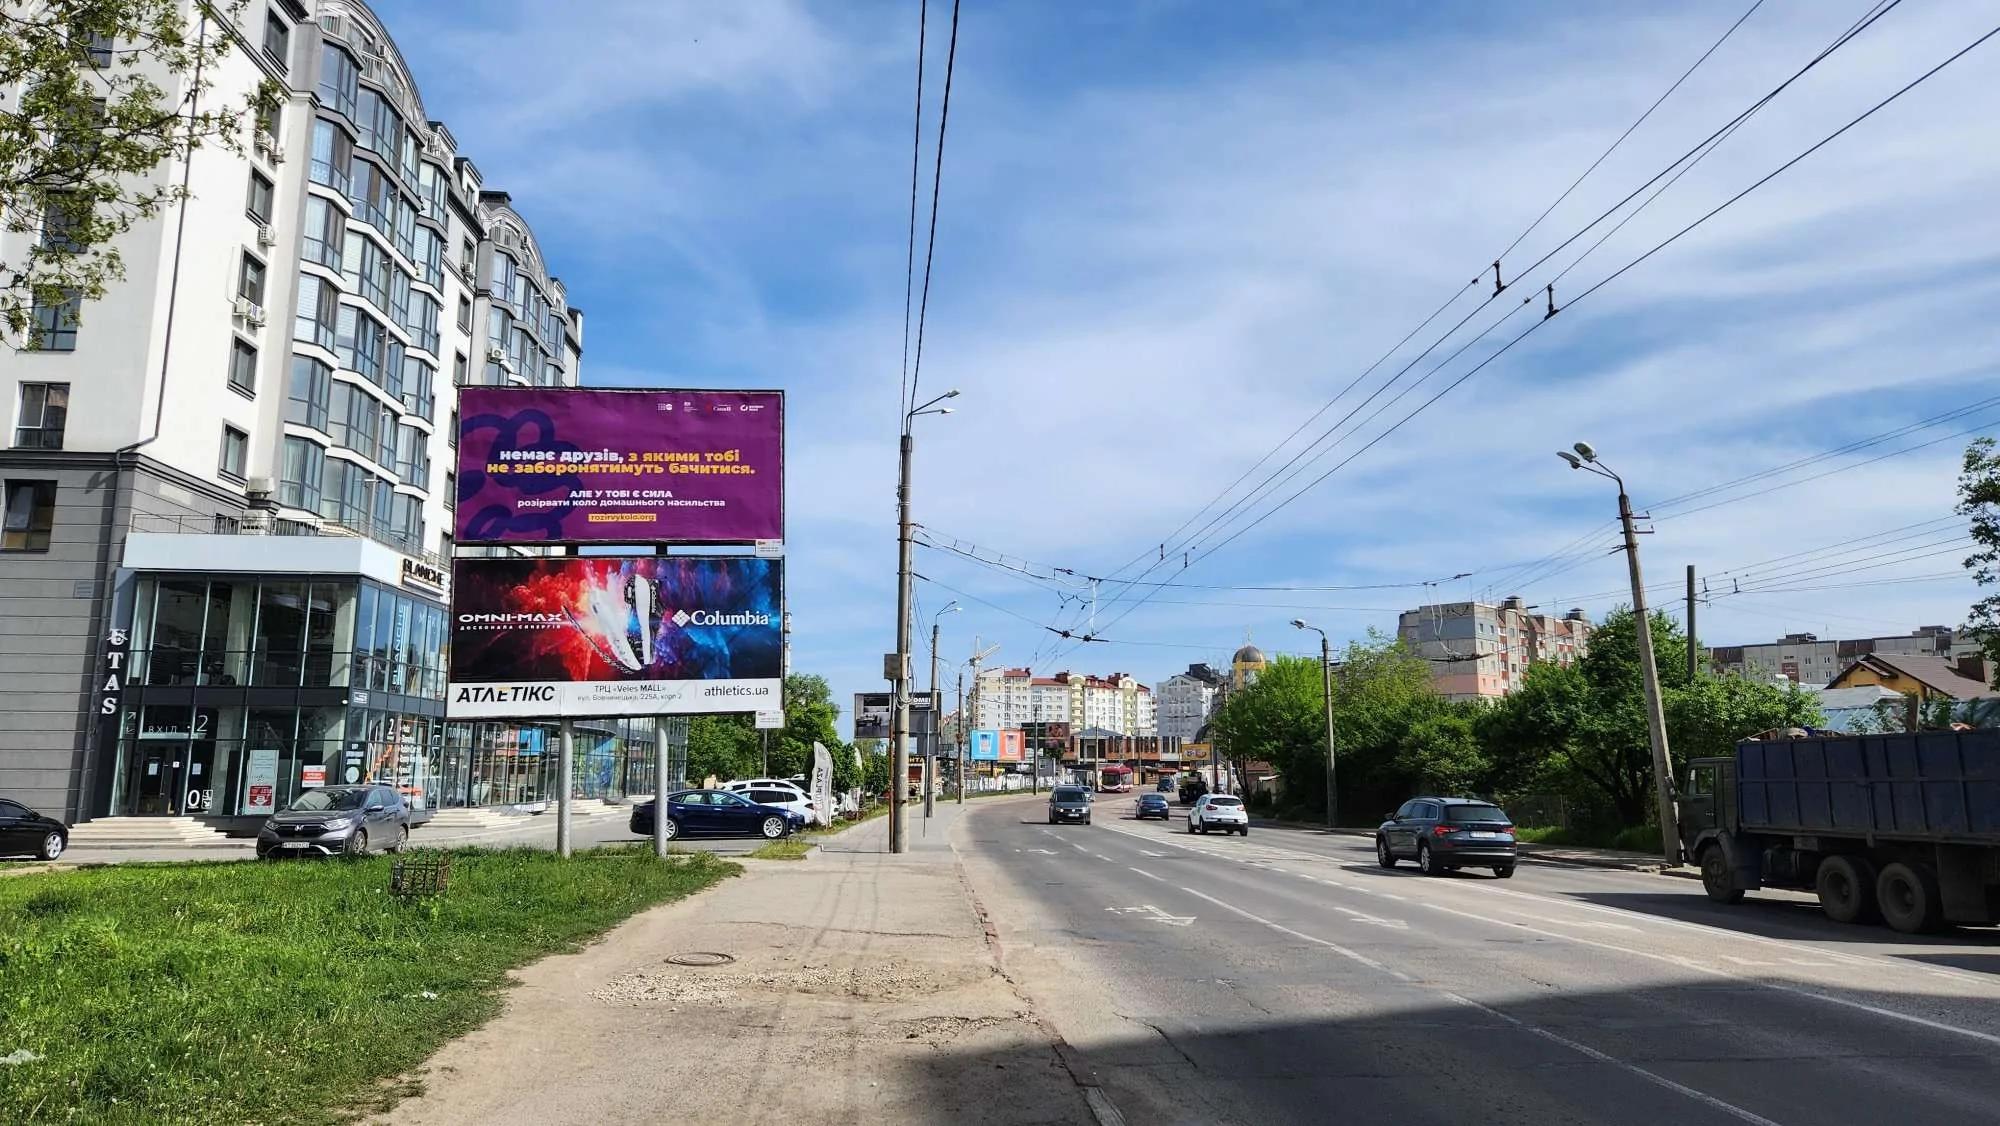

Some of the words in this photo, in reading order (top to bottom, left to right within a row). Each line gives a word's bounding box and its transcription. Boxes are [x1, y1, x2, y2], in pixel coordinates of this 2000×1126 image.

[500, 450, 555, 462] немає
[560, 449, 624, 464] друзів,
[628, 452, 637, 462] з
[643, 452, 699, 463] якими
[705, 450, 739, 463] тобі
[487, 464, 510, 473] не
[514, 462, 662, 476] заборонятимуть
[669, 462, 755, 475] бачитися.
[642, 491, 672, 499] СИЛА
[518, 499, 570, 508] розірвати
[600, 500, 664, 508] домашнього
[402, 558, 445, 585] BLANCHE
[459, 613, 562, 623] OMNI-MAX
[690, 610, 769, 625] Columbia
[594, 685, 611, 693] ТРЦ
[704, 685, 769, 697] athletics.ua
